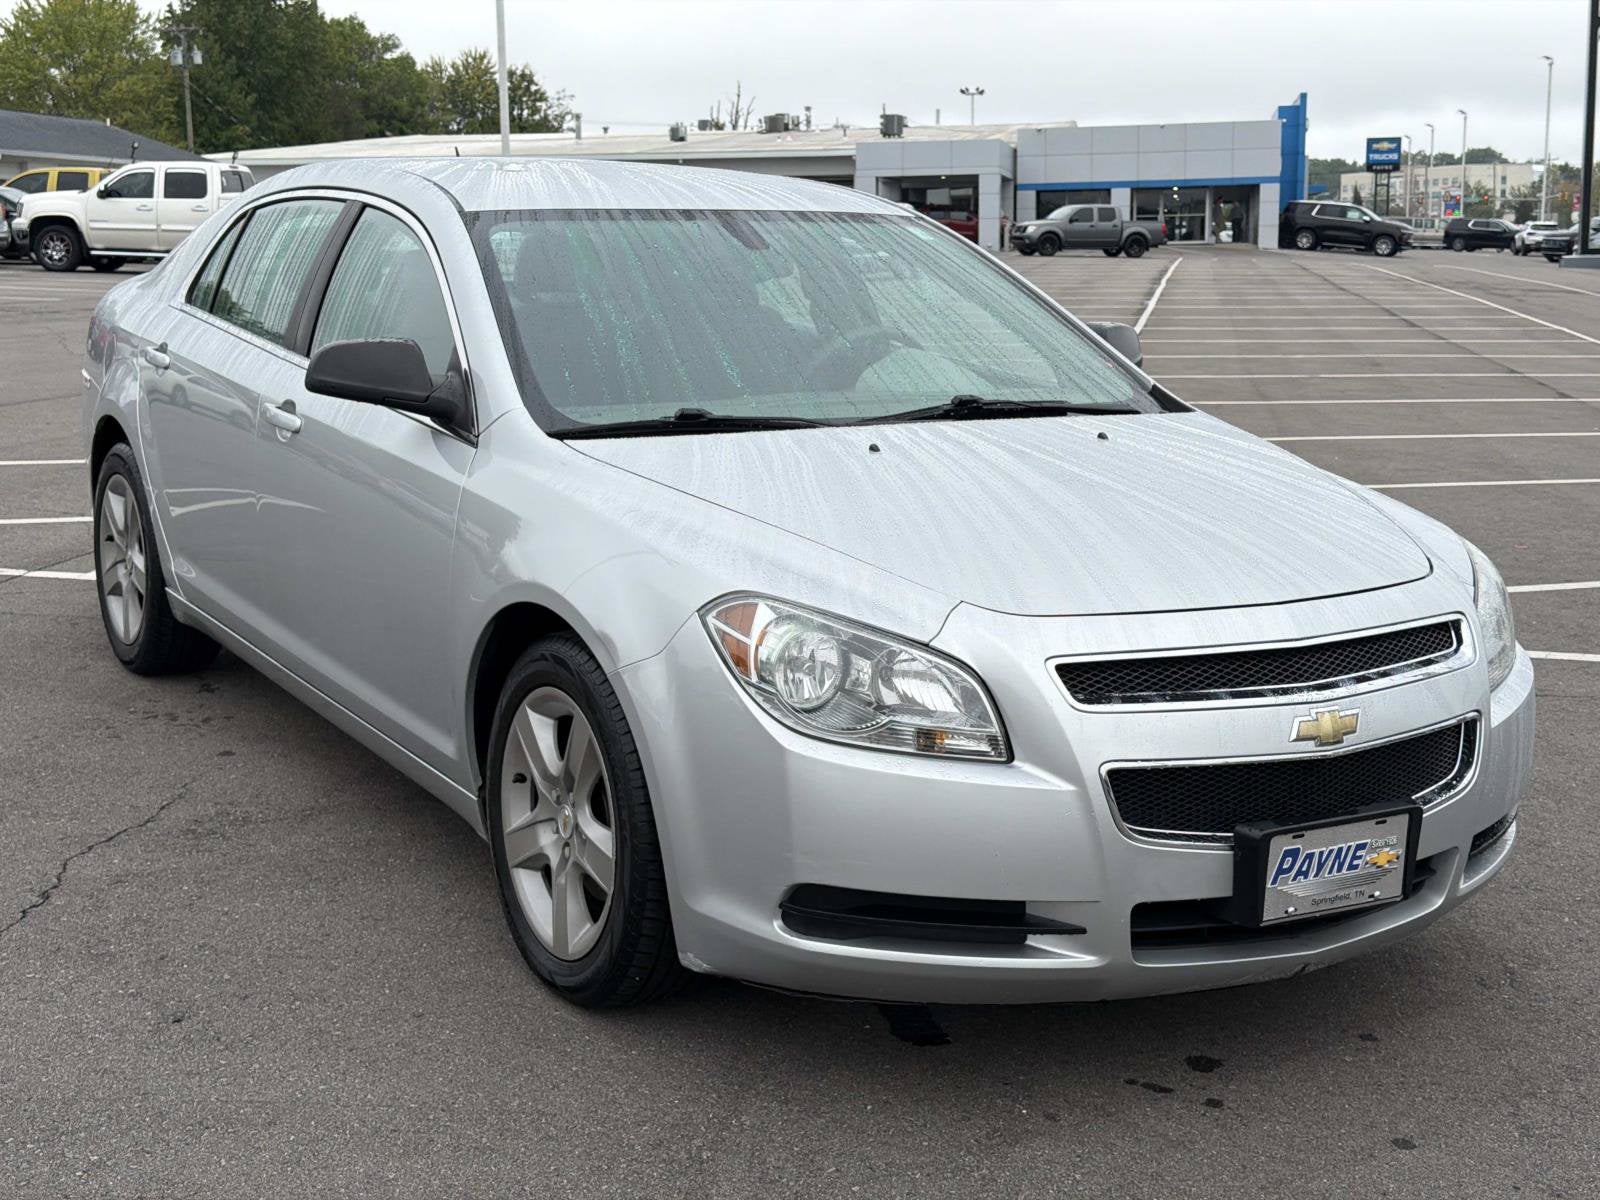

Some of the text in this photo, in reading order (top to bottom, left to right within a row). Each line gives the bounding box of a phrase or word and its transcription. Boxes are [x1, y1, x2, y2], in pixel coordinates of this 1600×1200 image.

[1369, 153, 1398, 161] TRUCKS
[1268, 840, 1370, 887] PAYNE
[1311, 889, 1365, 906] Springfield, TN
